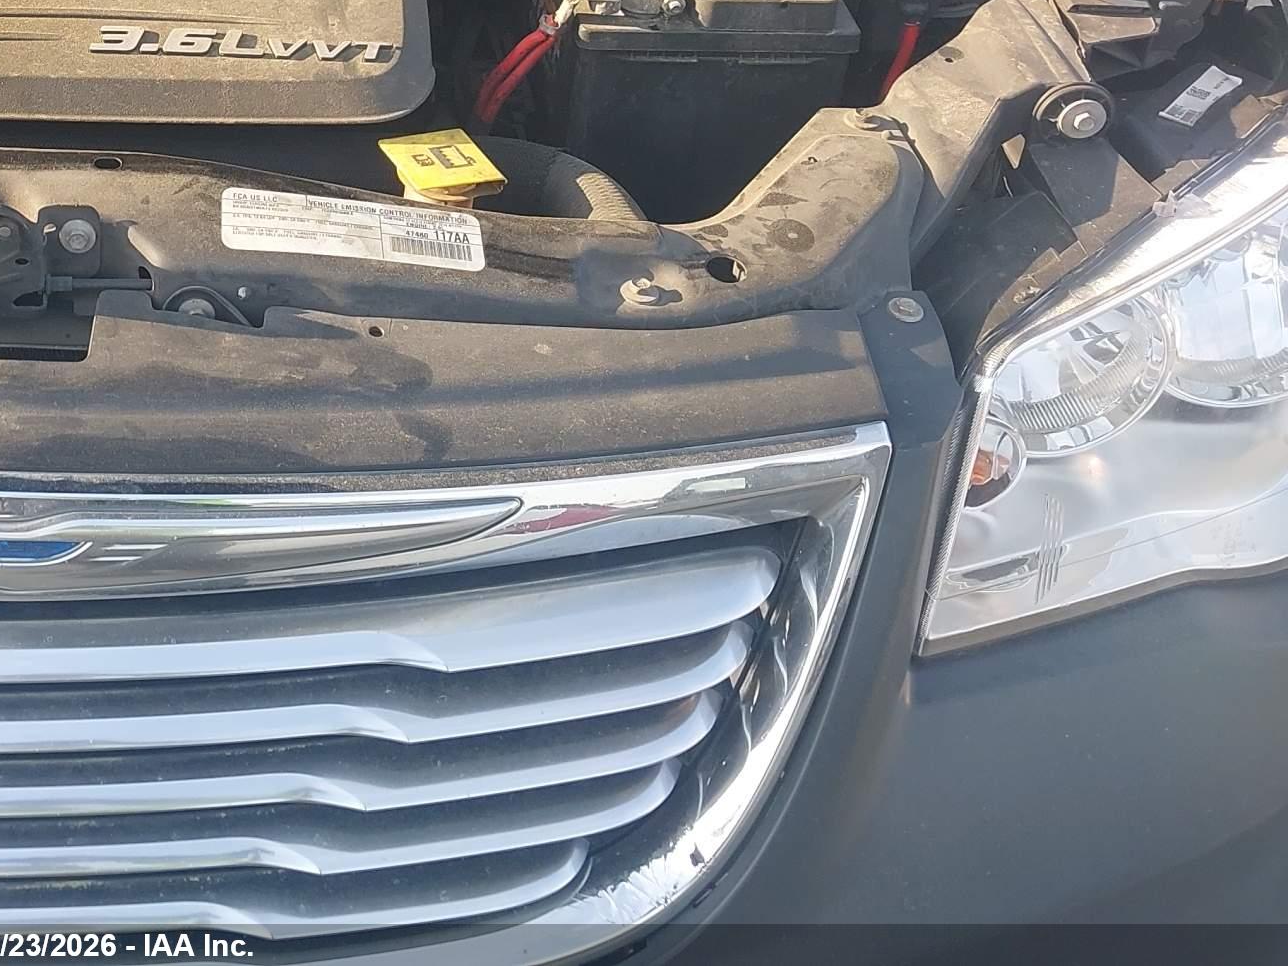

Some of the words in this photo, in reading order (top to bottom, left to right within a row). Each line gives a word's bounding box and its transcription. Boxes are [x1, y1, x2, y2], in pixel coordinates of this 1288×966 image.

[269, 37, 396, 62] VVT
[233, 192, 248, 200] FCA
[308, 200, 338, 210] VEHICLE
[341, 204, 377, 213] EMISSION
[379, 208, 412, 218] CONTROL
[416, 212, 468, 224] INFORMATION
[434, 230, 470, 244] 117AA
